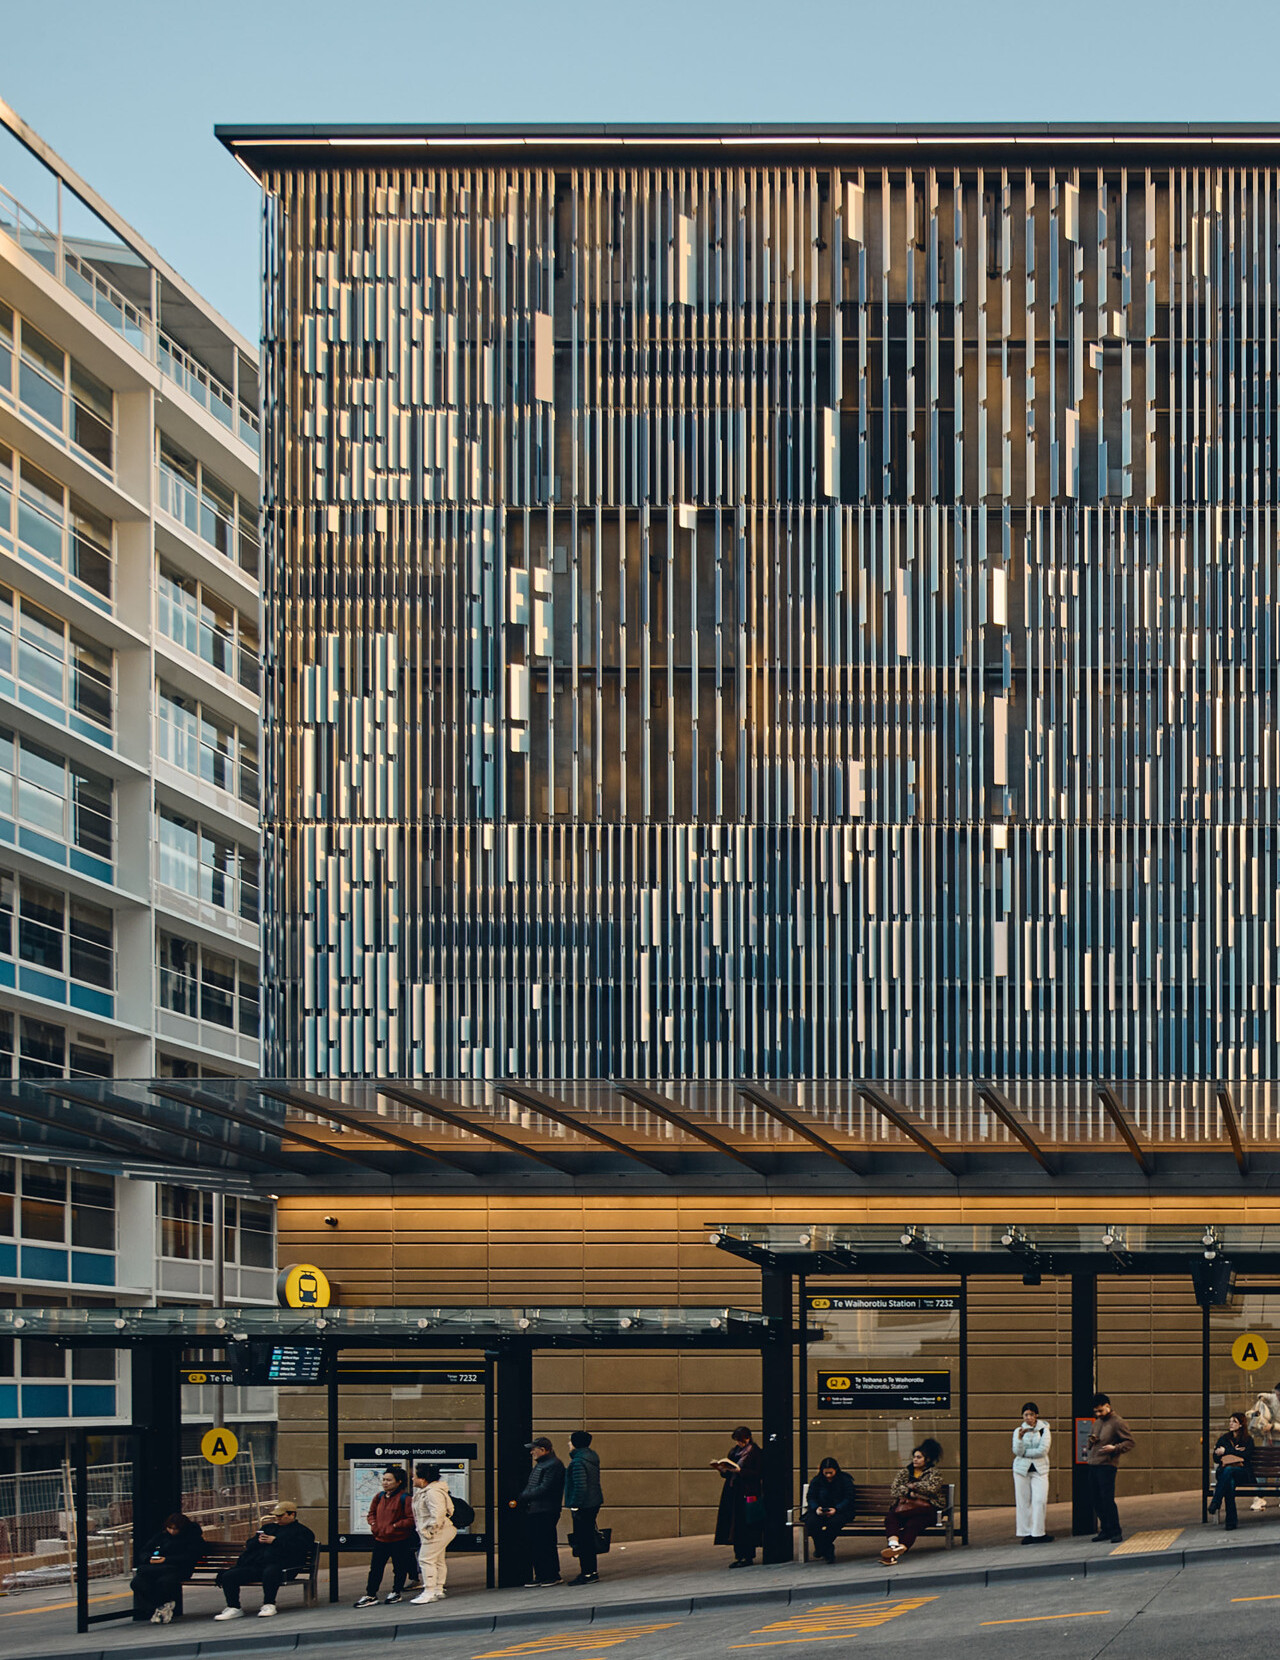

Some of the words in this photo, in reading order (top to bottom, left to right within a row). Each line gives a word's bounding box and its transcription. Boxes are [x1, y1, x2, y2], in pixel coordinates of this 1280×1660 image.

[845, 1299, 887, 1307] Waihorotiu
[889, 1299, 916, 1307] Station
[1242, 1342, 1258, 1361] A
[210, 1374, 220, 1382] Te
[459, 1374, 477, 1382] 7232
[211, 1437, 228, 1456] A
